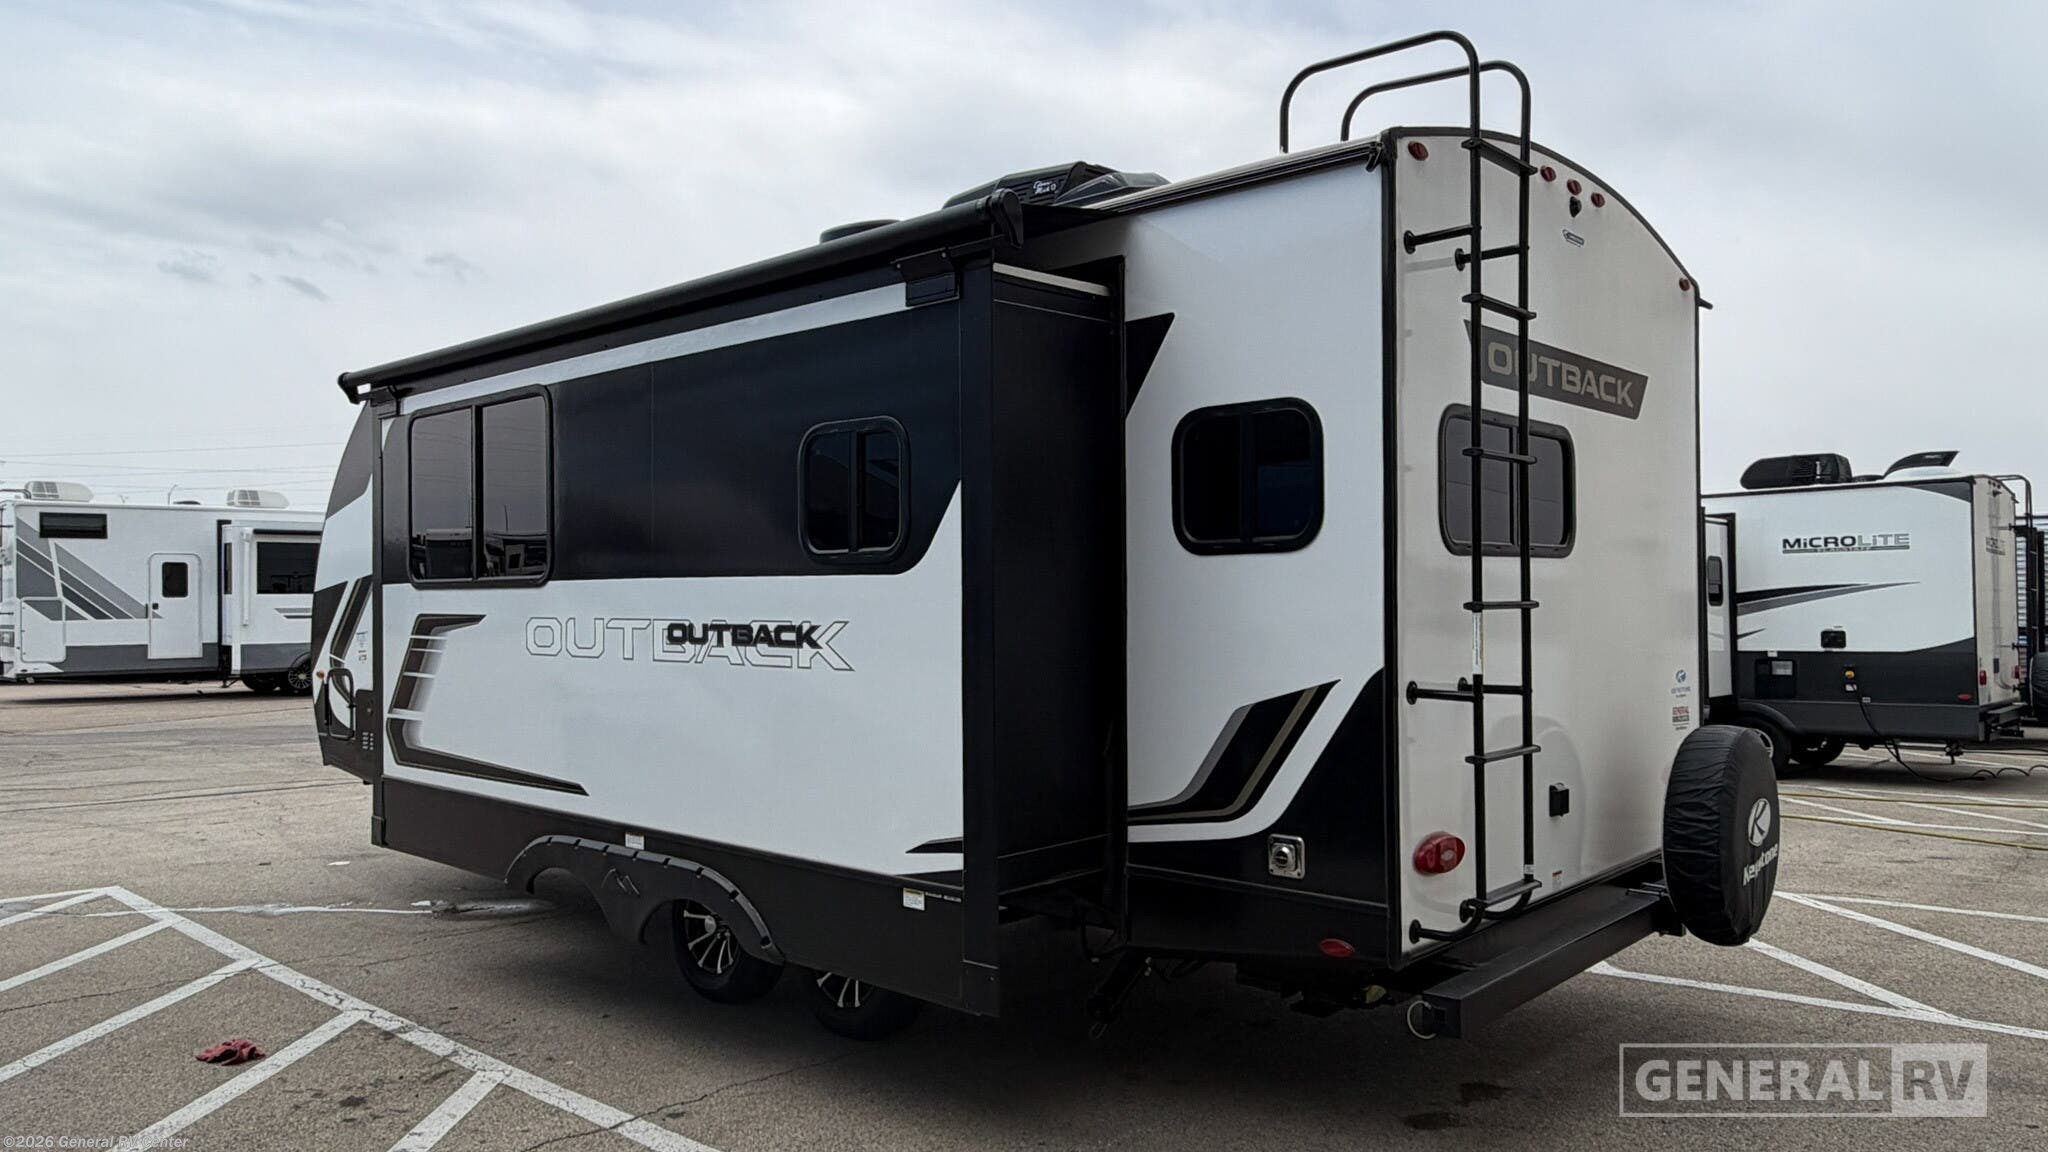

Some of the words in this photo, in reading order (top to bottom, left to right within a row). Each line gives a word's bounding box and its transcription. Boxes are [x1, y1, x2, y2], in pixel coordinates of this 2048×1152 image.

[1487, 341, 1634, 408] OUTBACK
[525, 617, 855, 671] OUTBACK
[667, 623, 823, 649] OUTBACK
